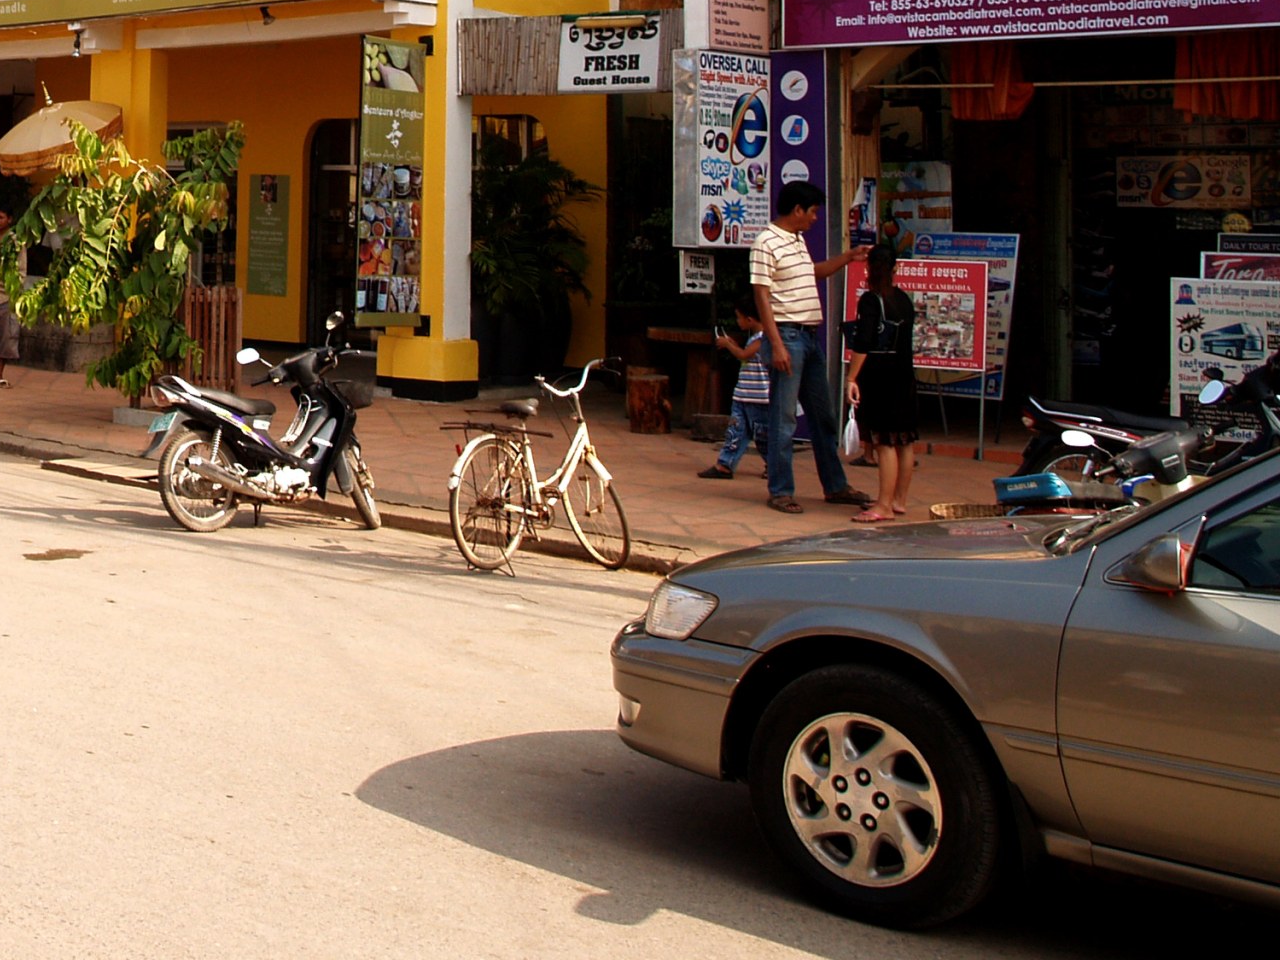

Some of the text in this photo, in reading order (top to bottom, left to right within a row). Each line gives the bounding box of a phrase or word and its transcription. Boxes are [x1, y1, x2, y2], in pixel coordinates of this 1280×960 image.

[869, 0, 888, 12] Tel:
[835, 16, 866, 27] Email:
[907, 14, 1169, 38] Website: www.avistacambodiatravel.com
[584, 54, 640, 72] FRESH
[700, 53, 768, 75] OVERSEA CALL
[573, 75, 650, 86] Guest House
[702, 158, 731, 179] skype
[1207, 157, 1249, 169] Google
[701, 184, 723, 196] msn
[1223, 242, 1245, 250] DAILY
[1248, 243, 1270, 251] TOUR
[930, 283, 971, 292] CAMBODIA
[1230, 431, 1252, 439] Sold
